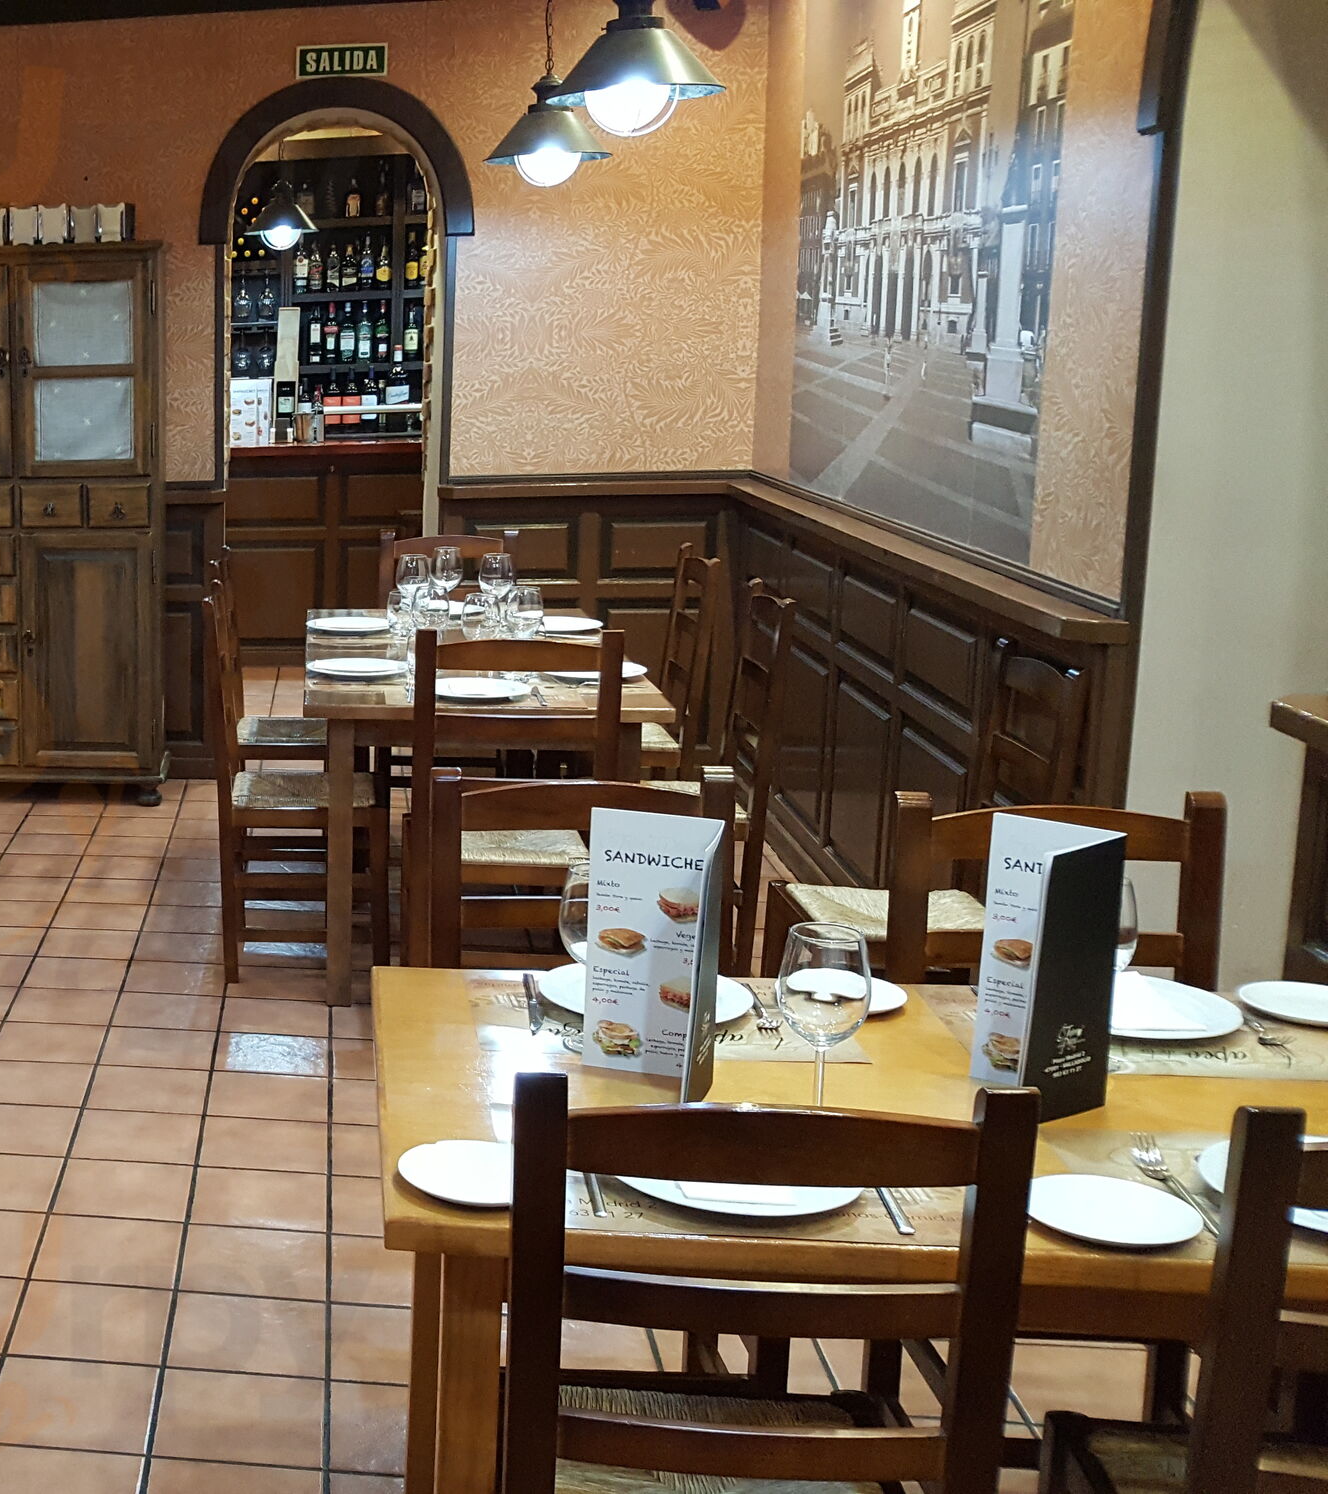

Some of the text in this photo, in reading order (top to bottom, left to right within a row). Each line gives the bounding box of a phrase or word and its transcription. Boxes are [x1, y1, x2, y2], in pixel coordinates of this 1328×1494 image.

[306, 50, 377, 72] SALIDA
[604, 849, 705, 872] SANDWICHE
[597, 880, 621, 888] Mixto
[593, 965, 630, 977] Especial
[986, 976, 1024, 989] Especial
[579, 1198, 641, 1208] Mdrid
